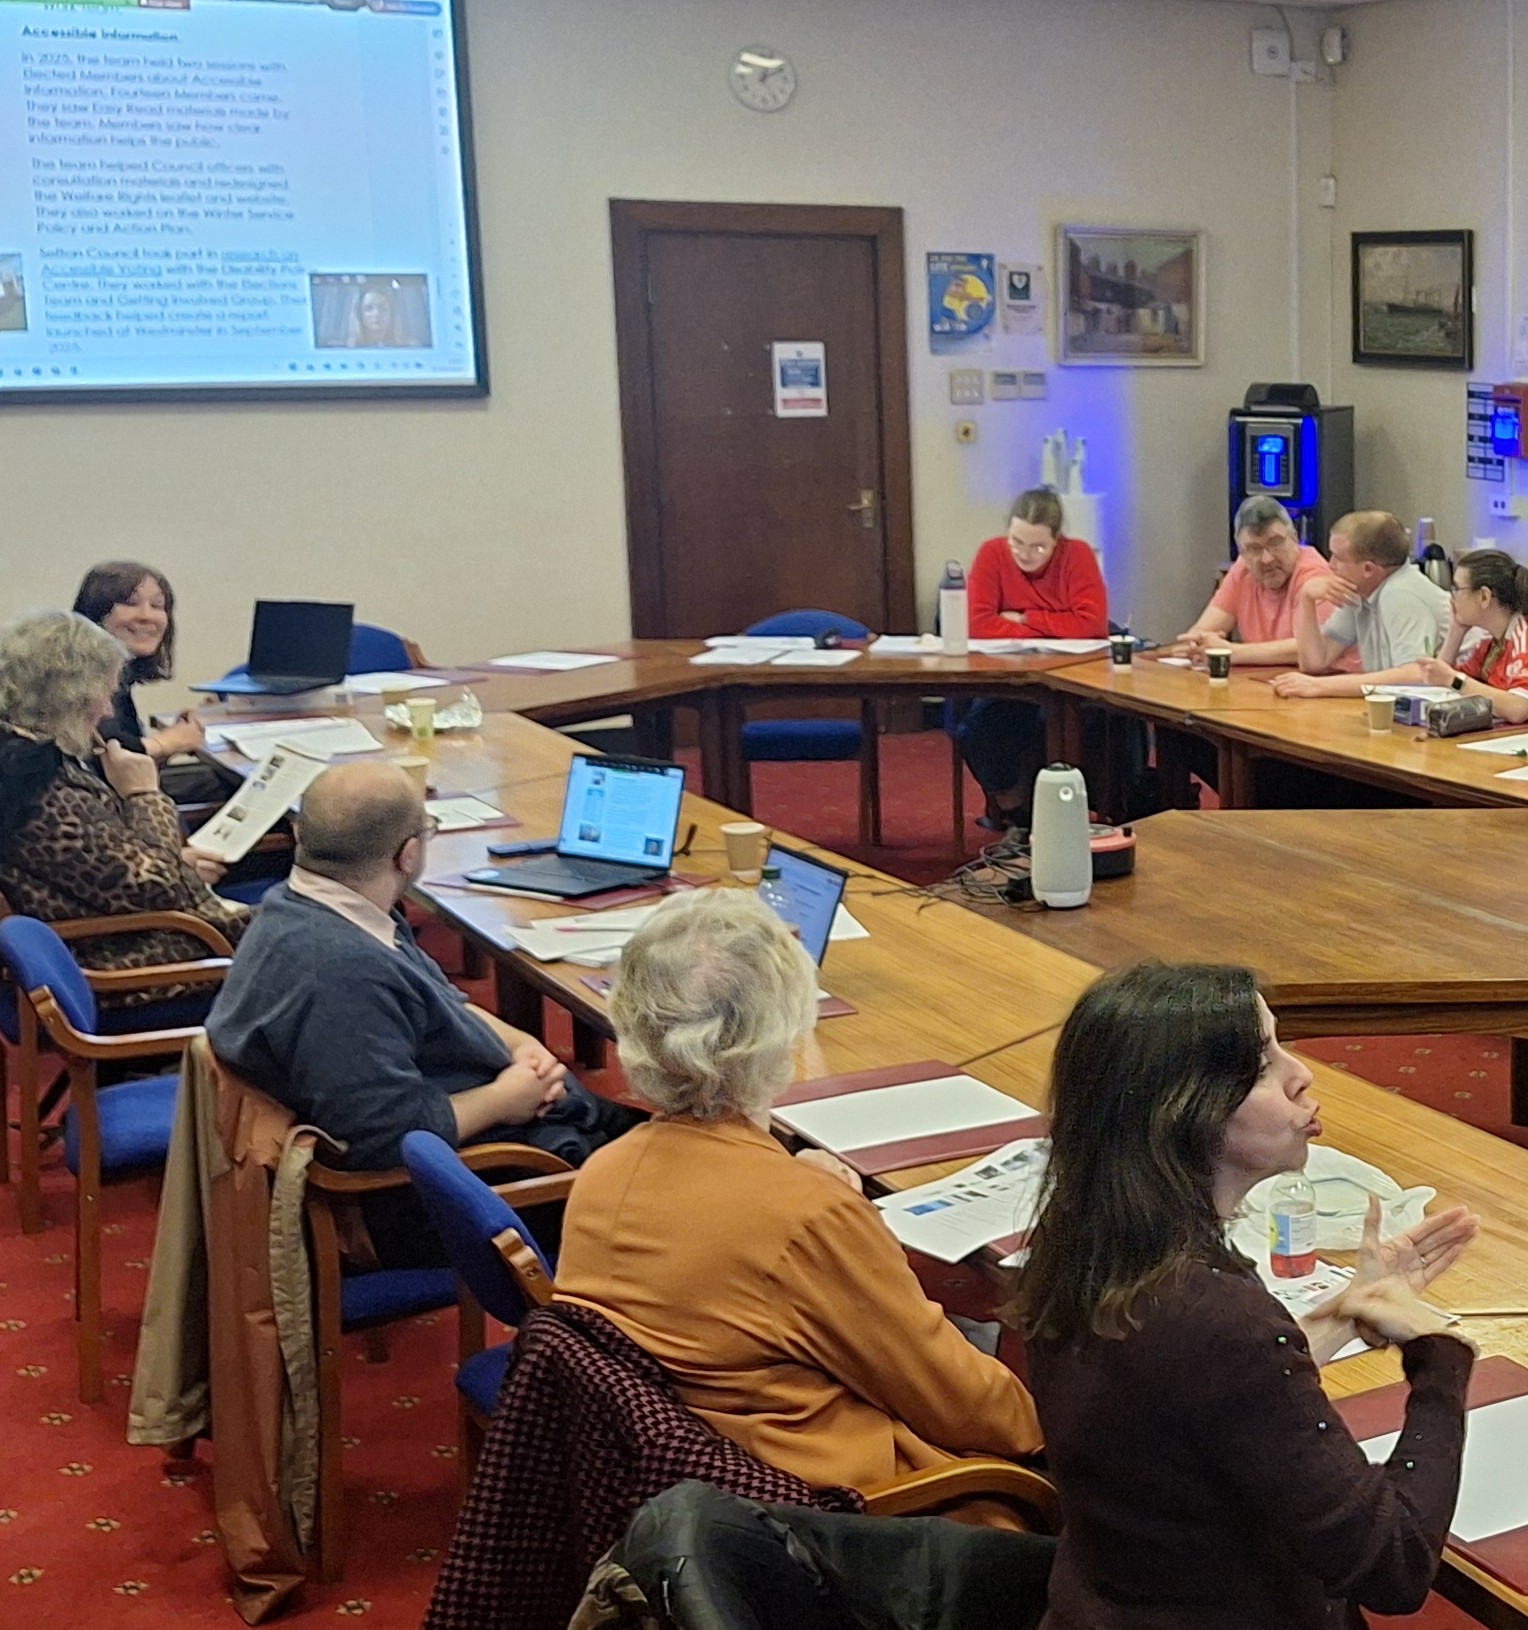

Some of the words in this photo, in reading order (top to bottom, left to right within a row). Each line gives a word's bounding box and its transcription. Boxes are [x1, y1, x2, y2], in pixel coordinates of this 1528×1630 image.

[21, 24, 97, 39] Accessible
[101, 27, 179, 41] Information
[77, 53, 100, 65] the
[80, 69, 144, 82] Members
[174, 88, 237, 101] Members
[27, 99, 58, 113] They
[99, 118, 162, 131] Members
[31, 156, 55, 169] The
[184, 177, 212, 188] and
[34, 189, 57, 201] the
[205, 191, 232, 203] and
[35, 205, 66, 219] They
[177, 207, 199, 219] the
[79, 221, 109, 233] and
[85, 247, 139, 259] Council
[196, 263, 218, 275] the
[216, 278, 238, 290] the
